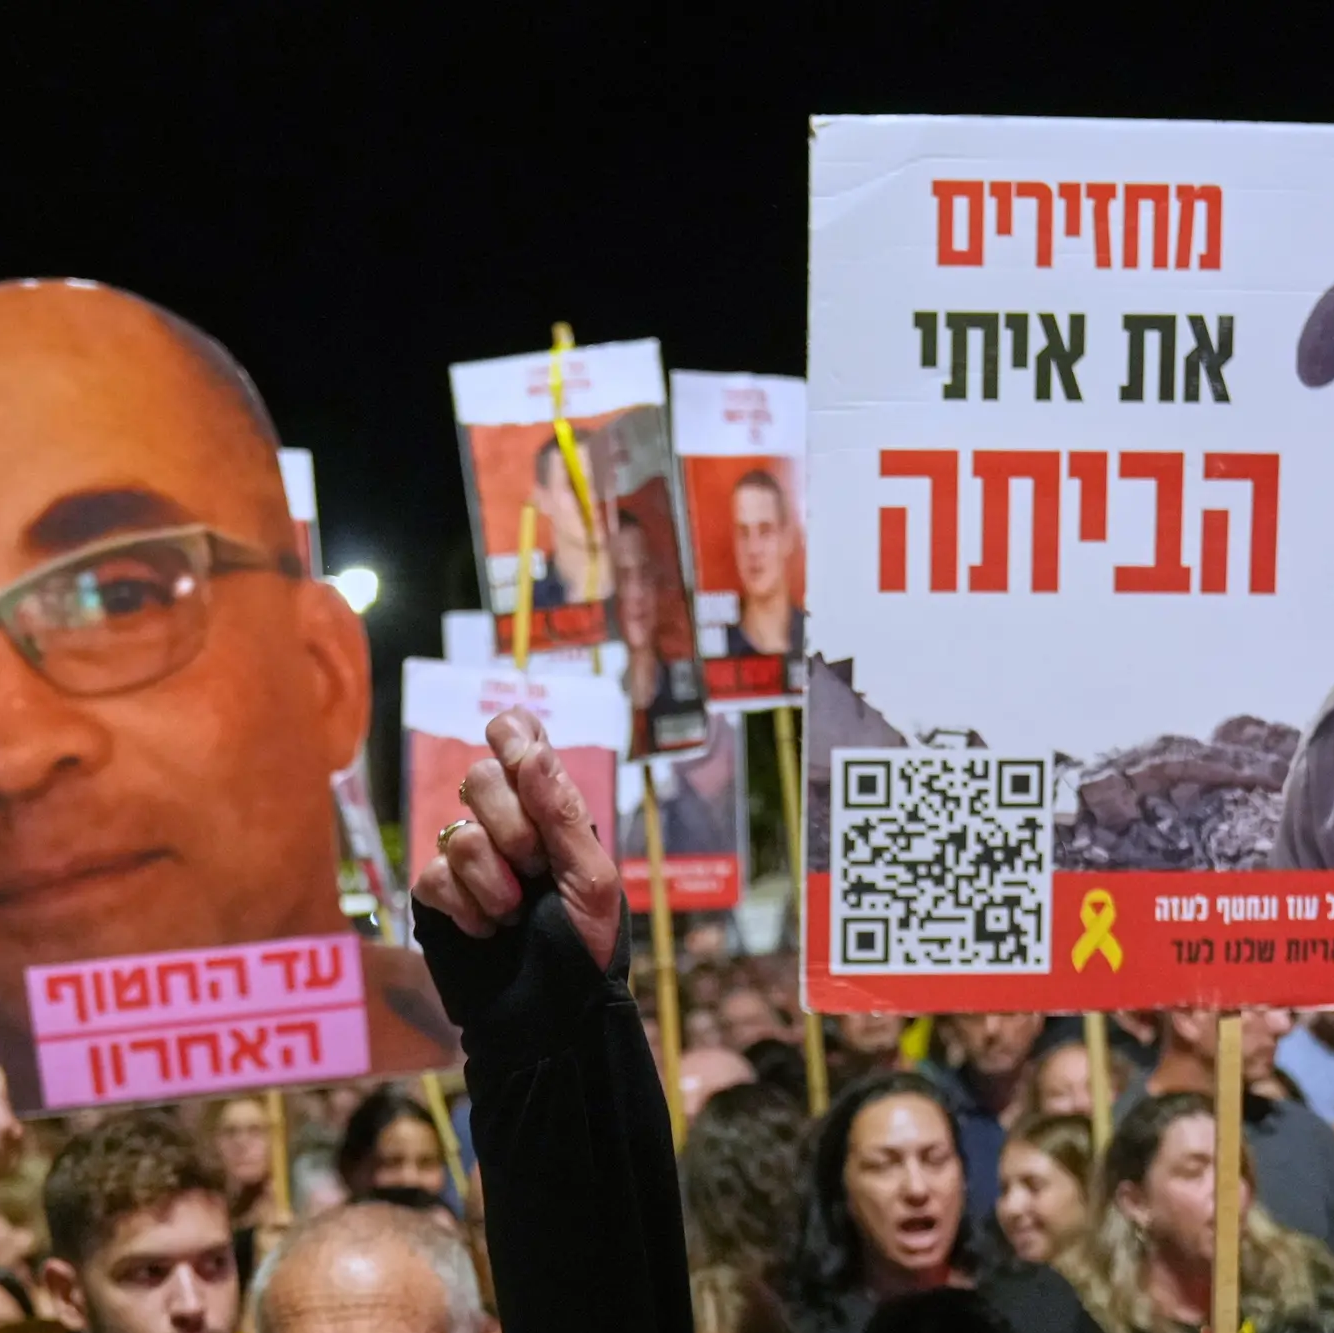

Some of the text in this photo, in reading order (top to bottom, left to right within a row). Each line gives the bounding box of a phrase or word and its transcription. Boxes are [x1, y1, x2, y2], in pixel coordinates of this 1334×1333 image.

[931, 178, 1224, 271] מחזירים
[912, 310, 1235, 403] את איתי
[878, 448, 1282, 595] הביתה
[1154, 893, 1210, 922] לעזה
[1216, 894, 1279, 926] ונחטף
[1285, 894, 1320, 921] עוז
[1171, 937, 1215, 965] לעד
[1224, 937, 1276, 964] שלנו
[45, 944, 345, 1024] עד החטוף
[88, 1021, 323, 1097] האחרון
